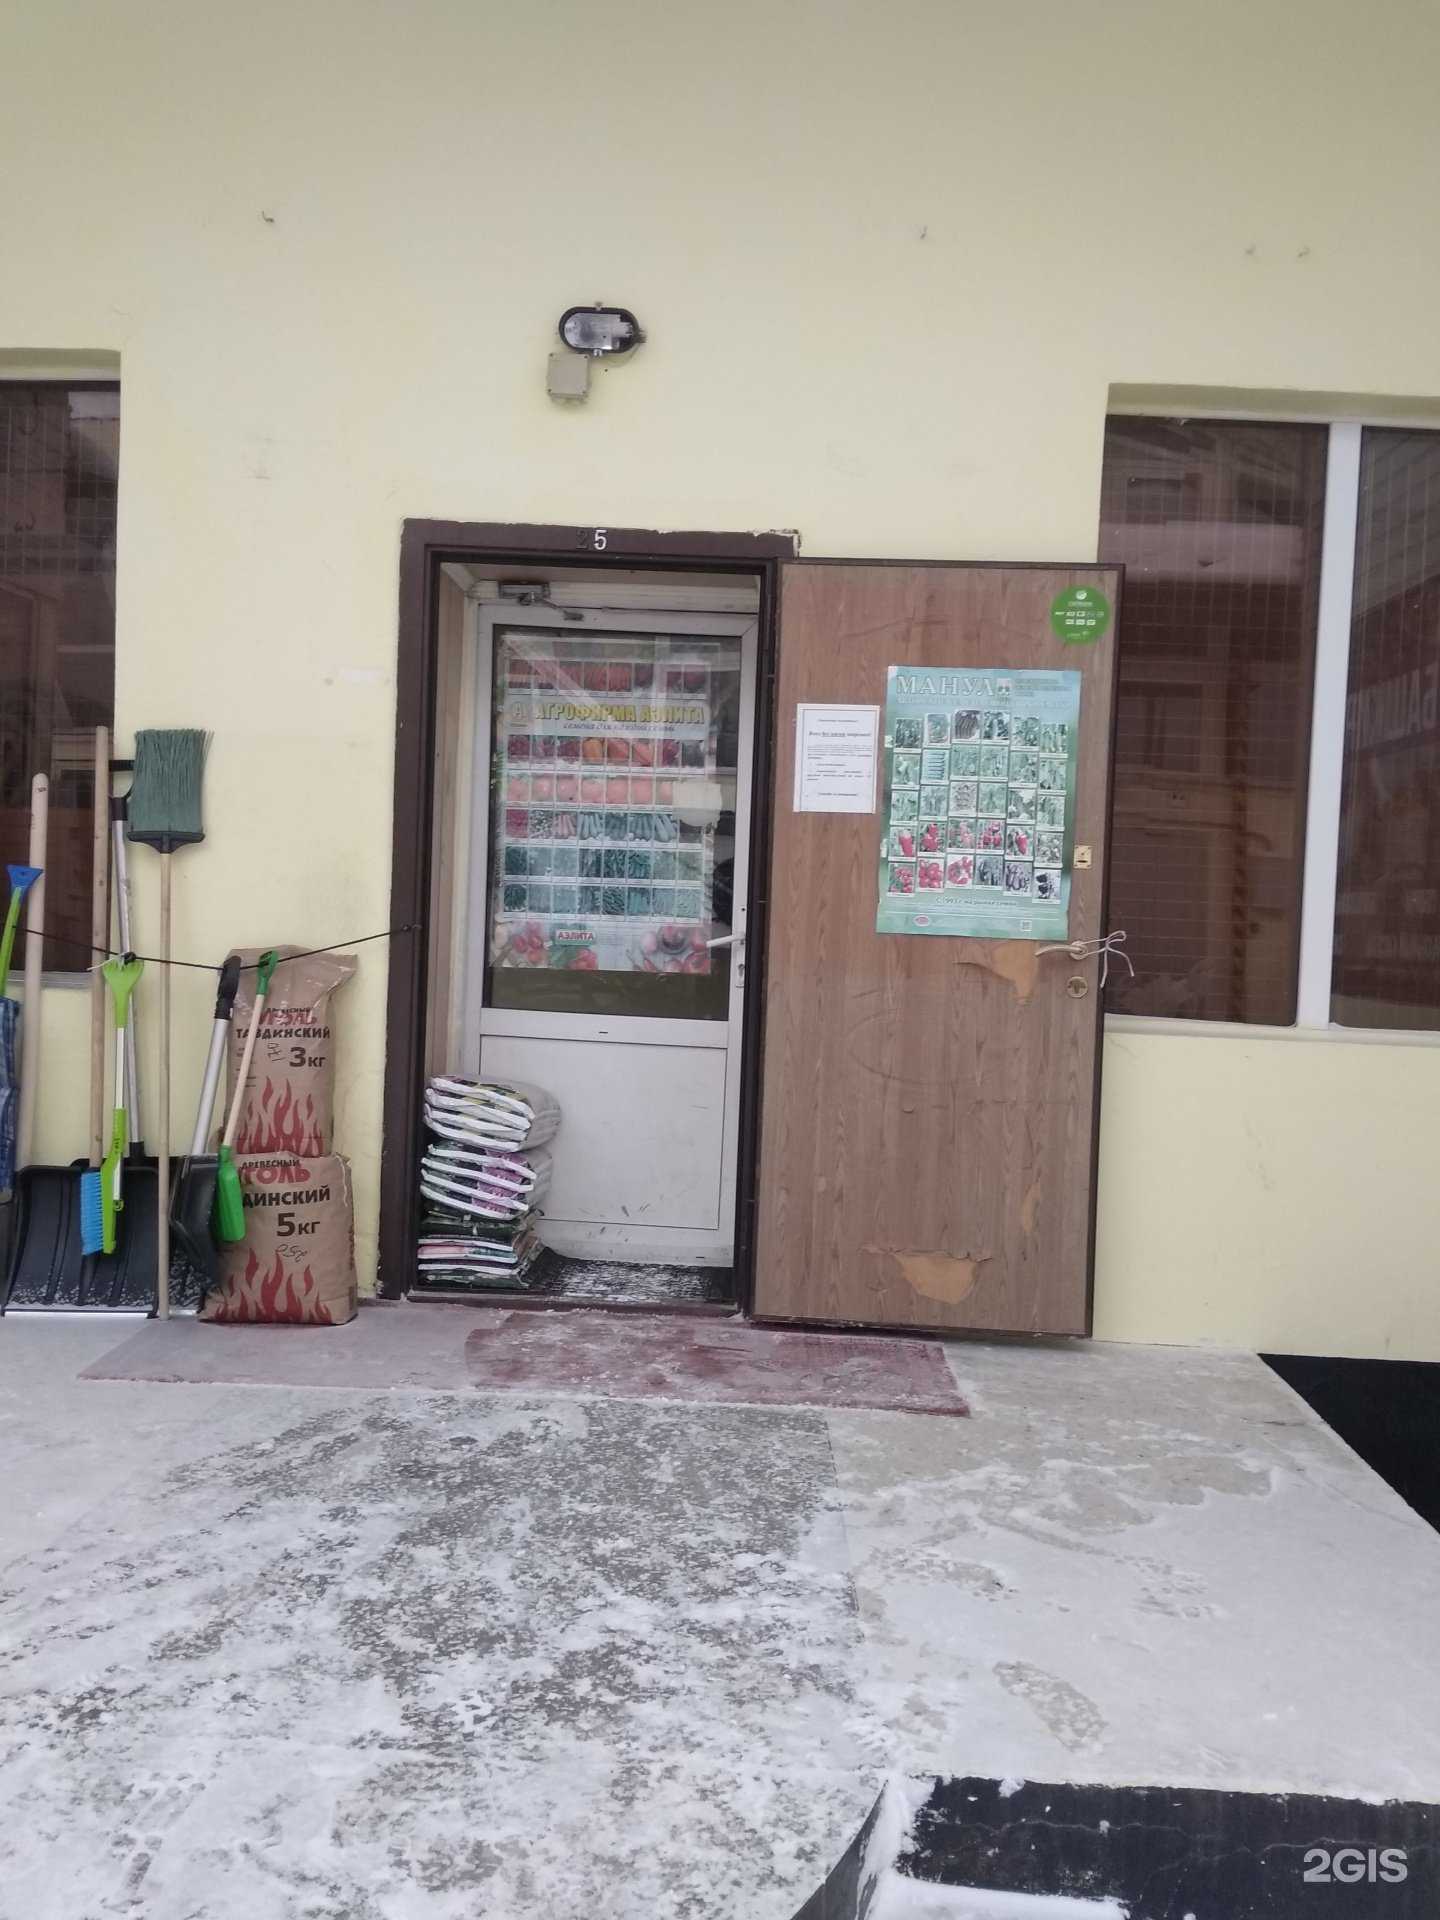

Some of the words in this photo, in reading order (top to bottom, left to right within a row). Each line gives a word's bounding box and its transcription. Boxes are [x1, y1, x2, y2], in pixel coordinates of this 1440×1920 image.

[896, 675, 995, 697] МАНУЛ
[558, 931, 594, 941] АЭЛИТА
[289, 1046, 306, 1067] 3
[308, 1057, 326, 1067] кг
[241, 1159, 300, 1170] ДРЕВЕСНЫЙ
[237, 1166, 311, 1184] ГОЛЬ
[276, 1212, 296, 1237] 5
[298, 1221, 321, 1236] кг
